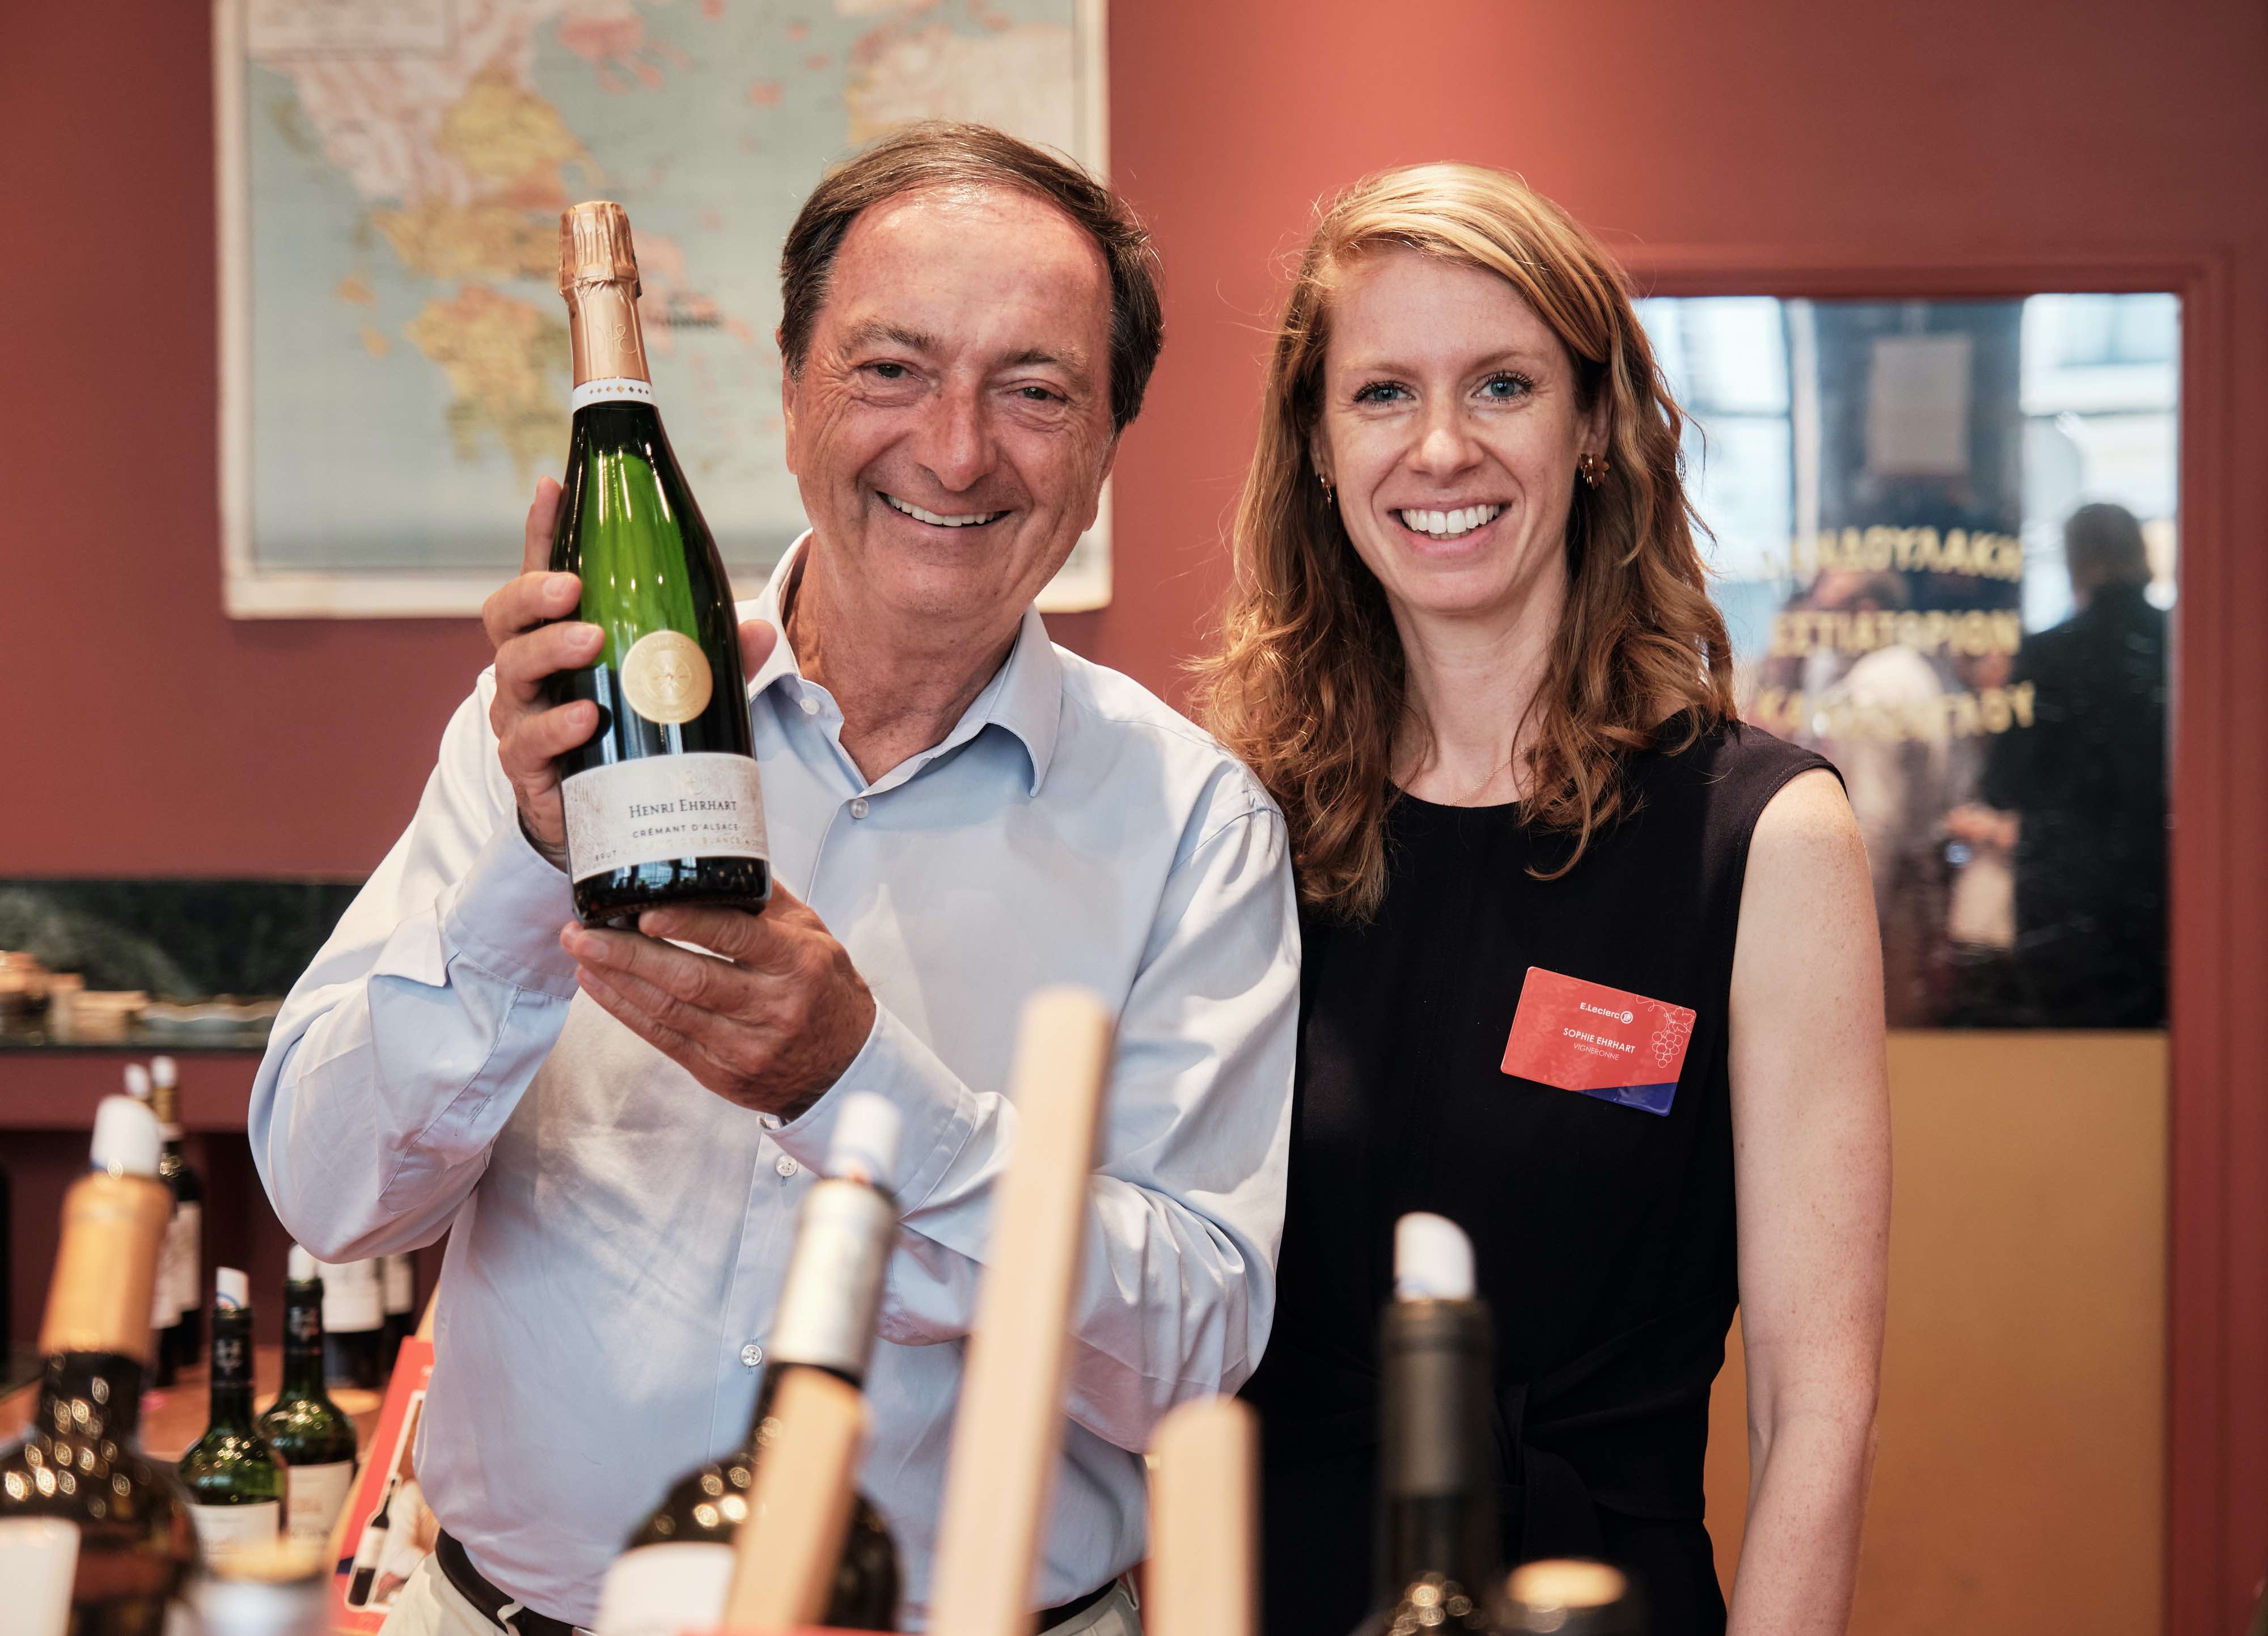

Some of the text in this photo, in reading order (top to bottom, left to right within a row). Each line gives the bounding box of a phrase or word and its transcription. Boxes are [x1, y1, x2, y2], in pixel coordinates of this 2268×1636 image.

[632, 823, 740, 838] CRÉMANT D'ALSACE
[594, 849, 616, 861] BRUT
[1580, 1002, 1620, 1019] E.Leclerc
[1563, 1028, 1636, 1054] SOPHIE EHRHART
[1573, 1043, 1620, 1061] VIGNERONNE
